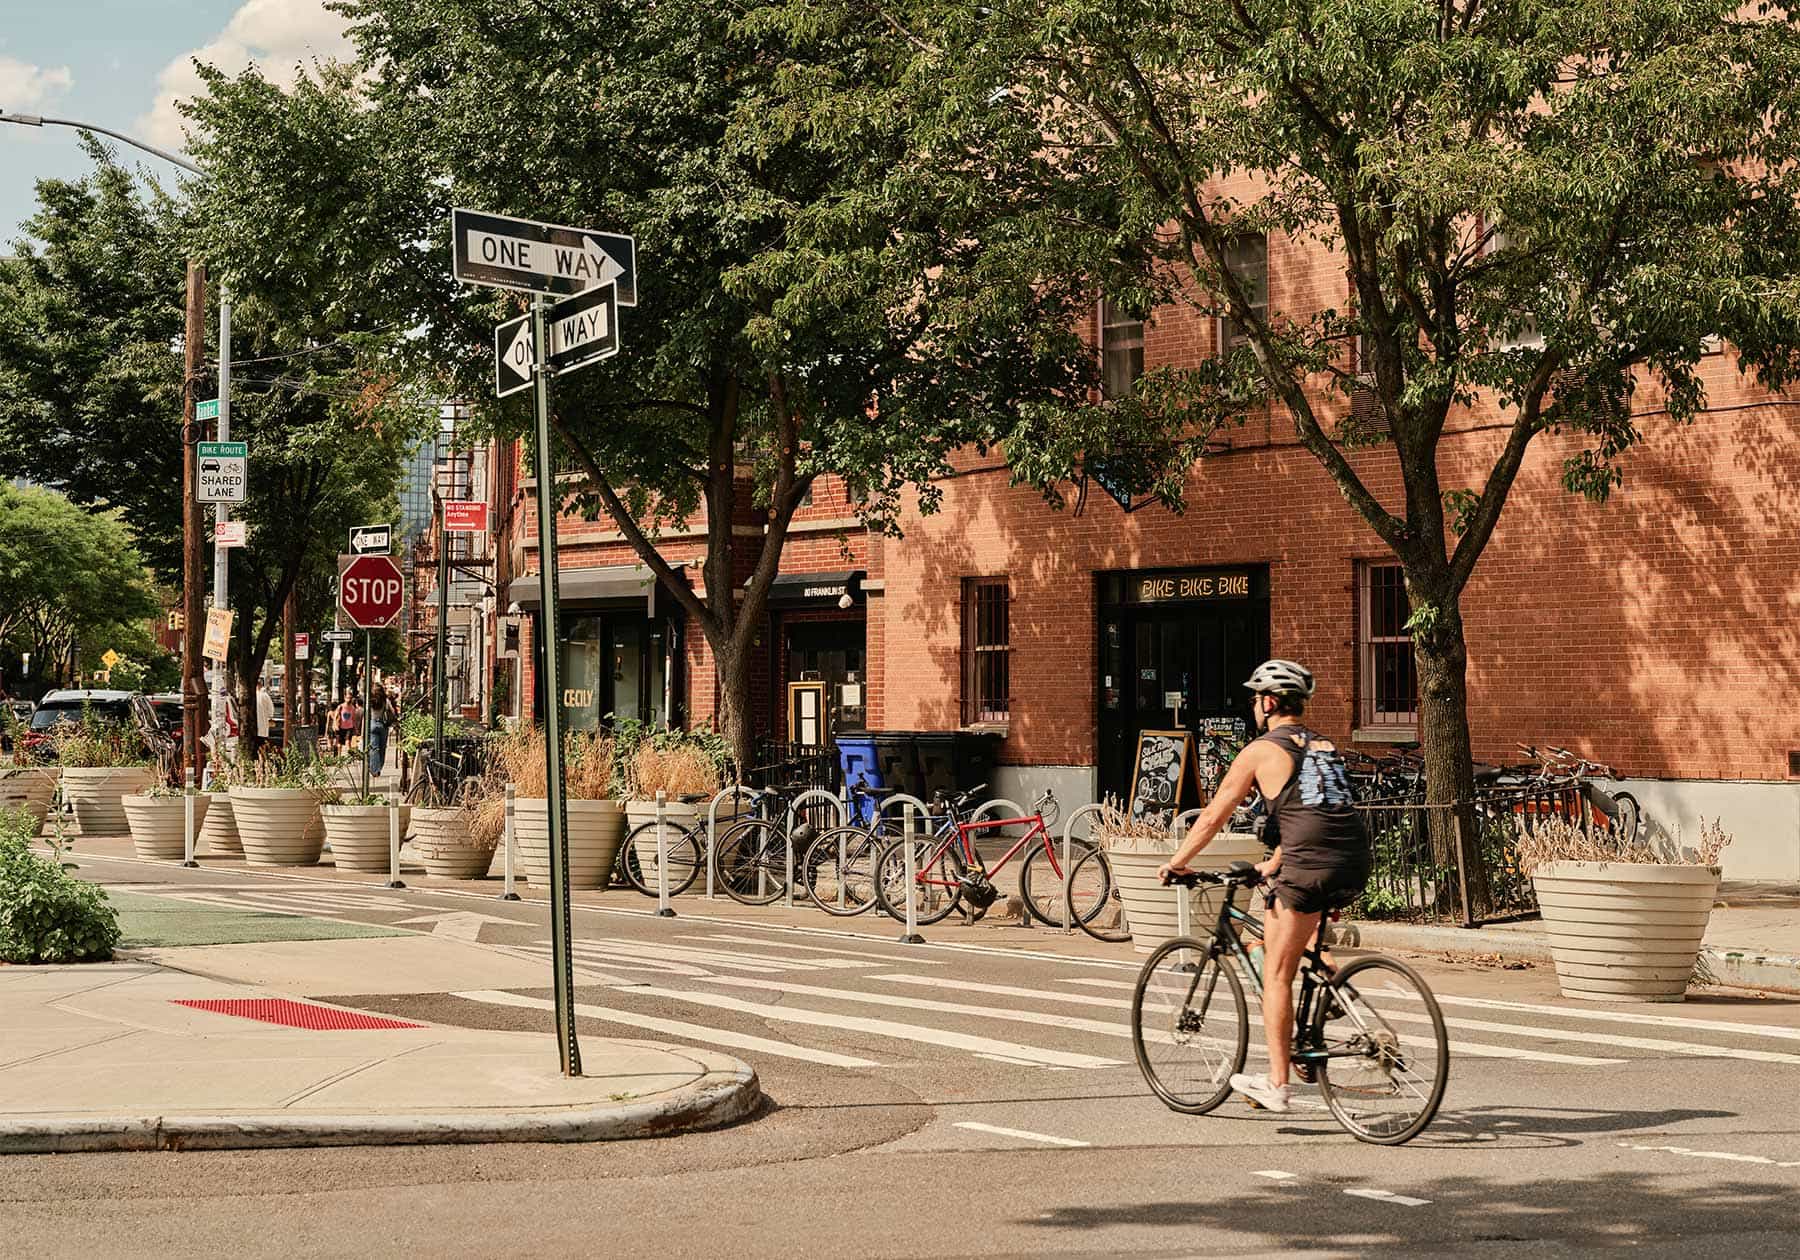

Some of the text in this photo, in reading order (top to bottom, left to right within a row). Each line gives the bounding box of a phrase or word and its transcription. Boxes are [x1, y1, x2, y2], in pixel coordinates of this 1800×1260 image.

[482, 236, 607, 279] ONE WAY
[563, 310, 600, 347] WAY
[201, 445, 243, 454] BIKE ROUTE
[201, 475, 242, 486] SHARED
[207, 487, 235, 497] LANE
[356, 535, 387, 547] ONE WAY
[345, 578, 400, 604] STOP
[1143, 579, 1176, 598] BIKE
[1180, 577, 1214, 597] BIKE
[564, 689, 594, 707] CECILY
